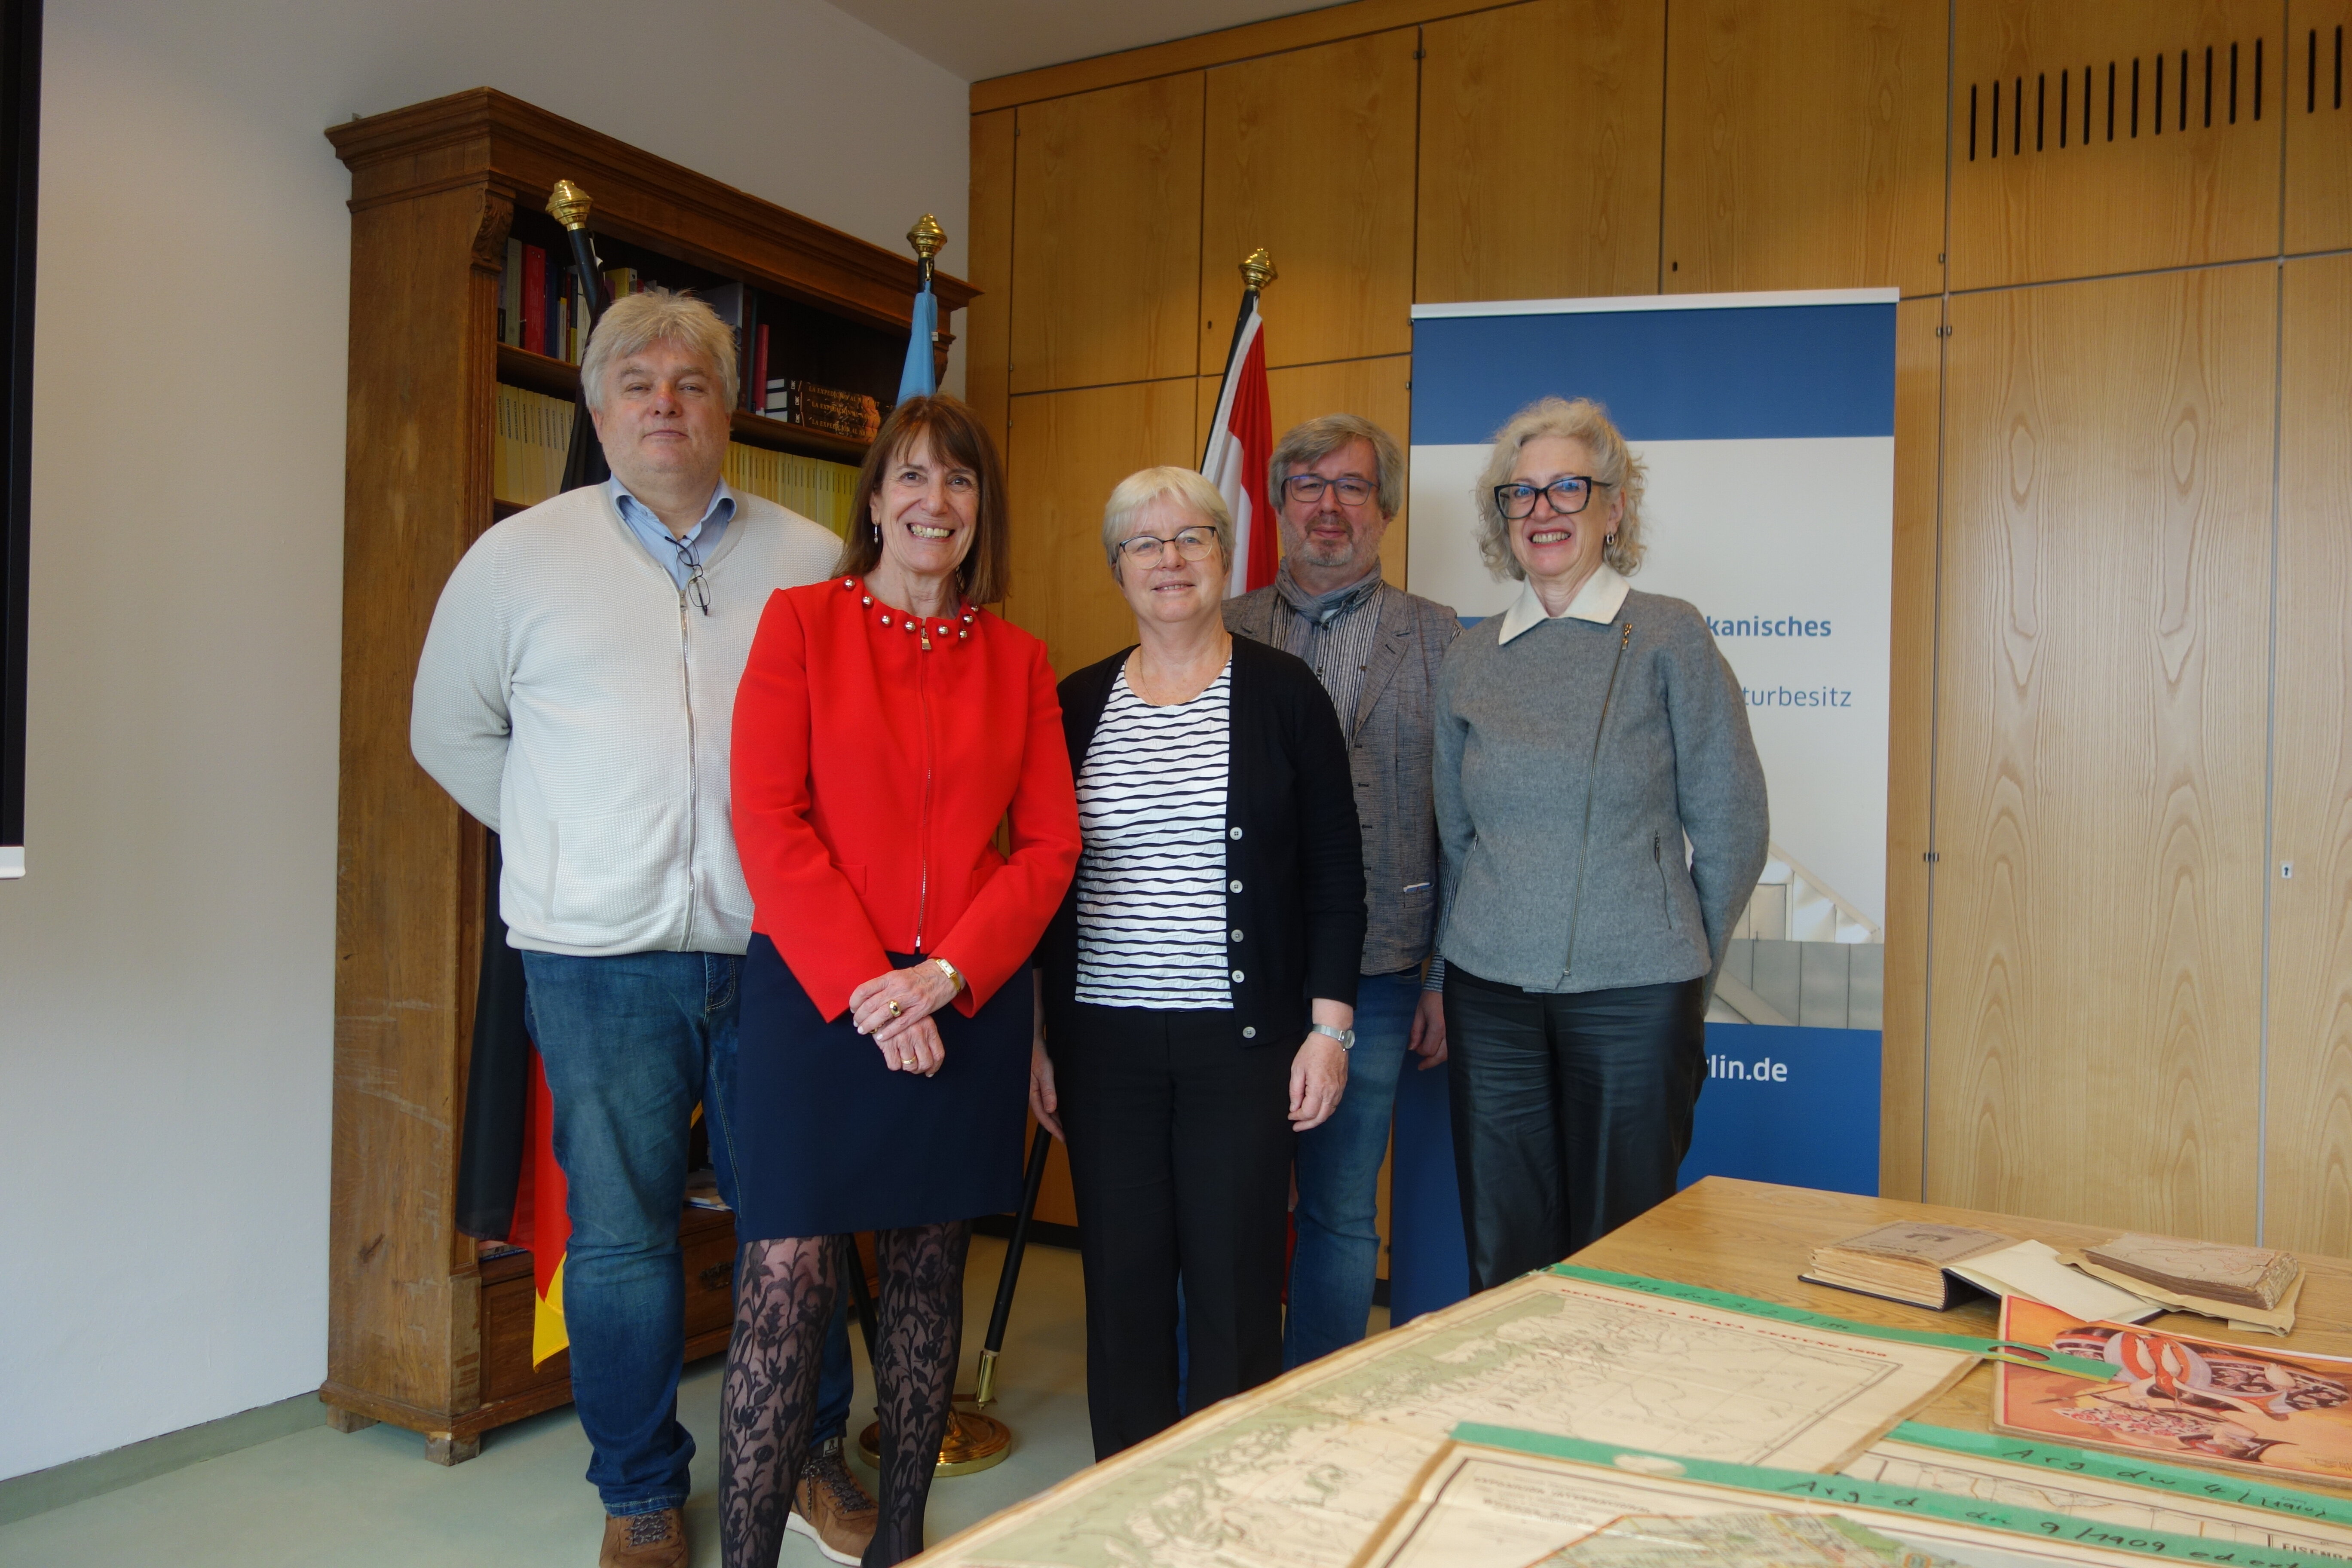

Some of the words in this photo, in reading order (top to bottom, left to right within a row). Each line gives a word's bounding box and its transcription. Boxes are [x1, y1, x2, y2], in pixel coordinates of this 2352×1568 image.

[1706, 616, 1831, 637] kanisches
[1742, 686, 1851, 707] turbesitz
[1706, 1054, 1788, 1082] lin.de
[2002, 1449, 2086, 1470] Arg
